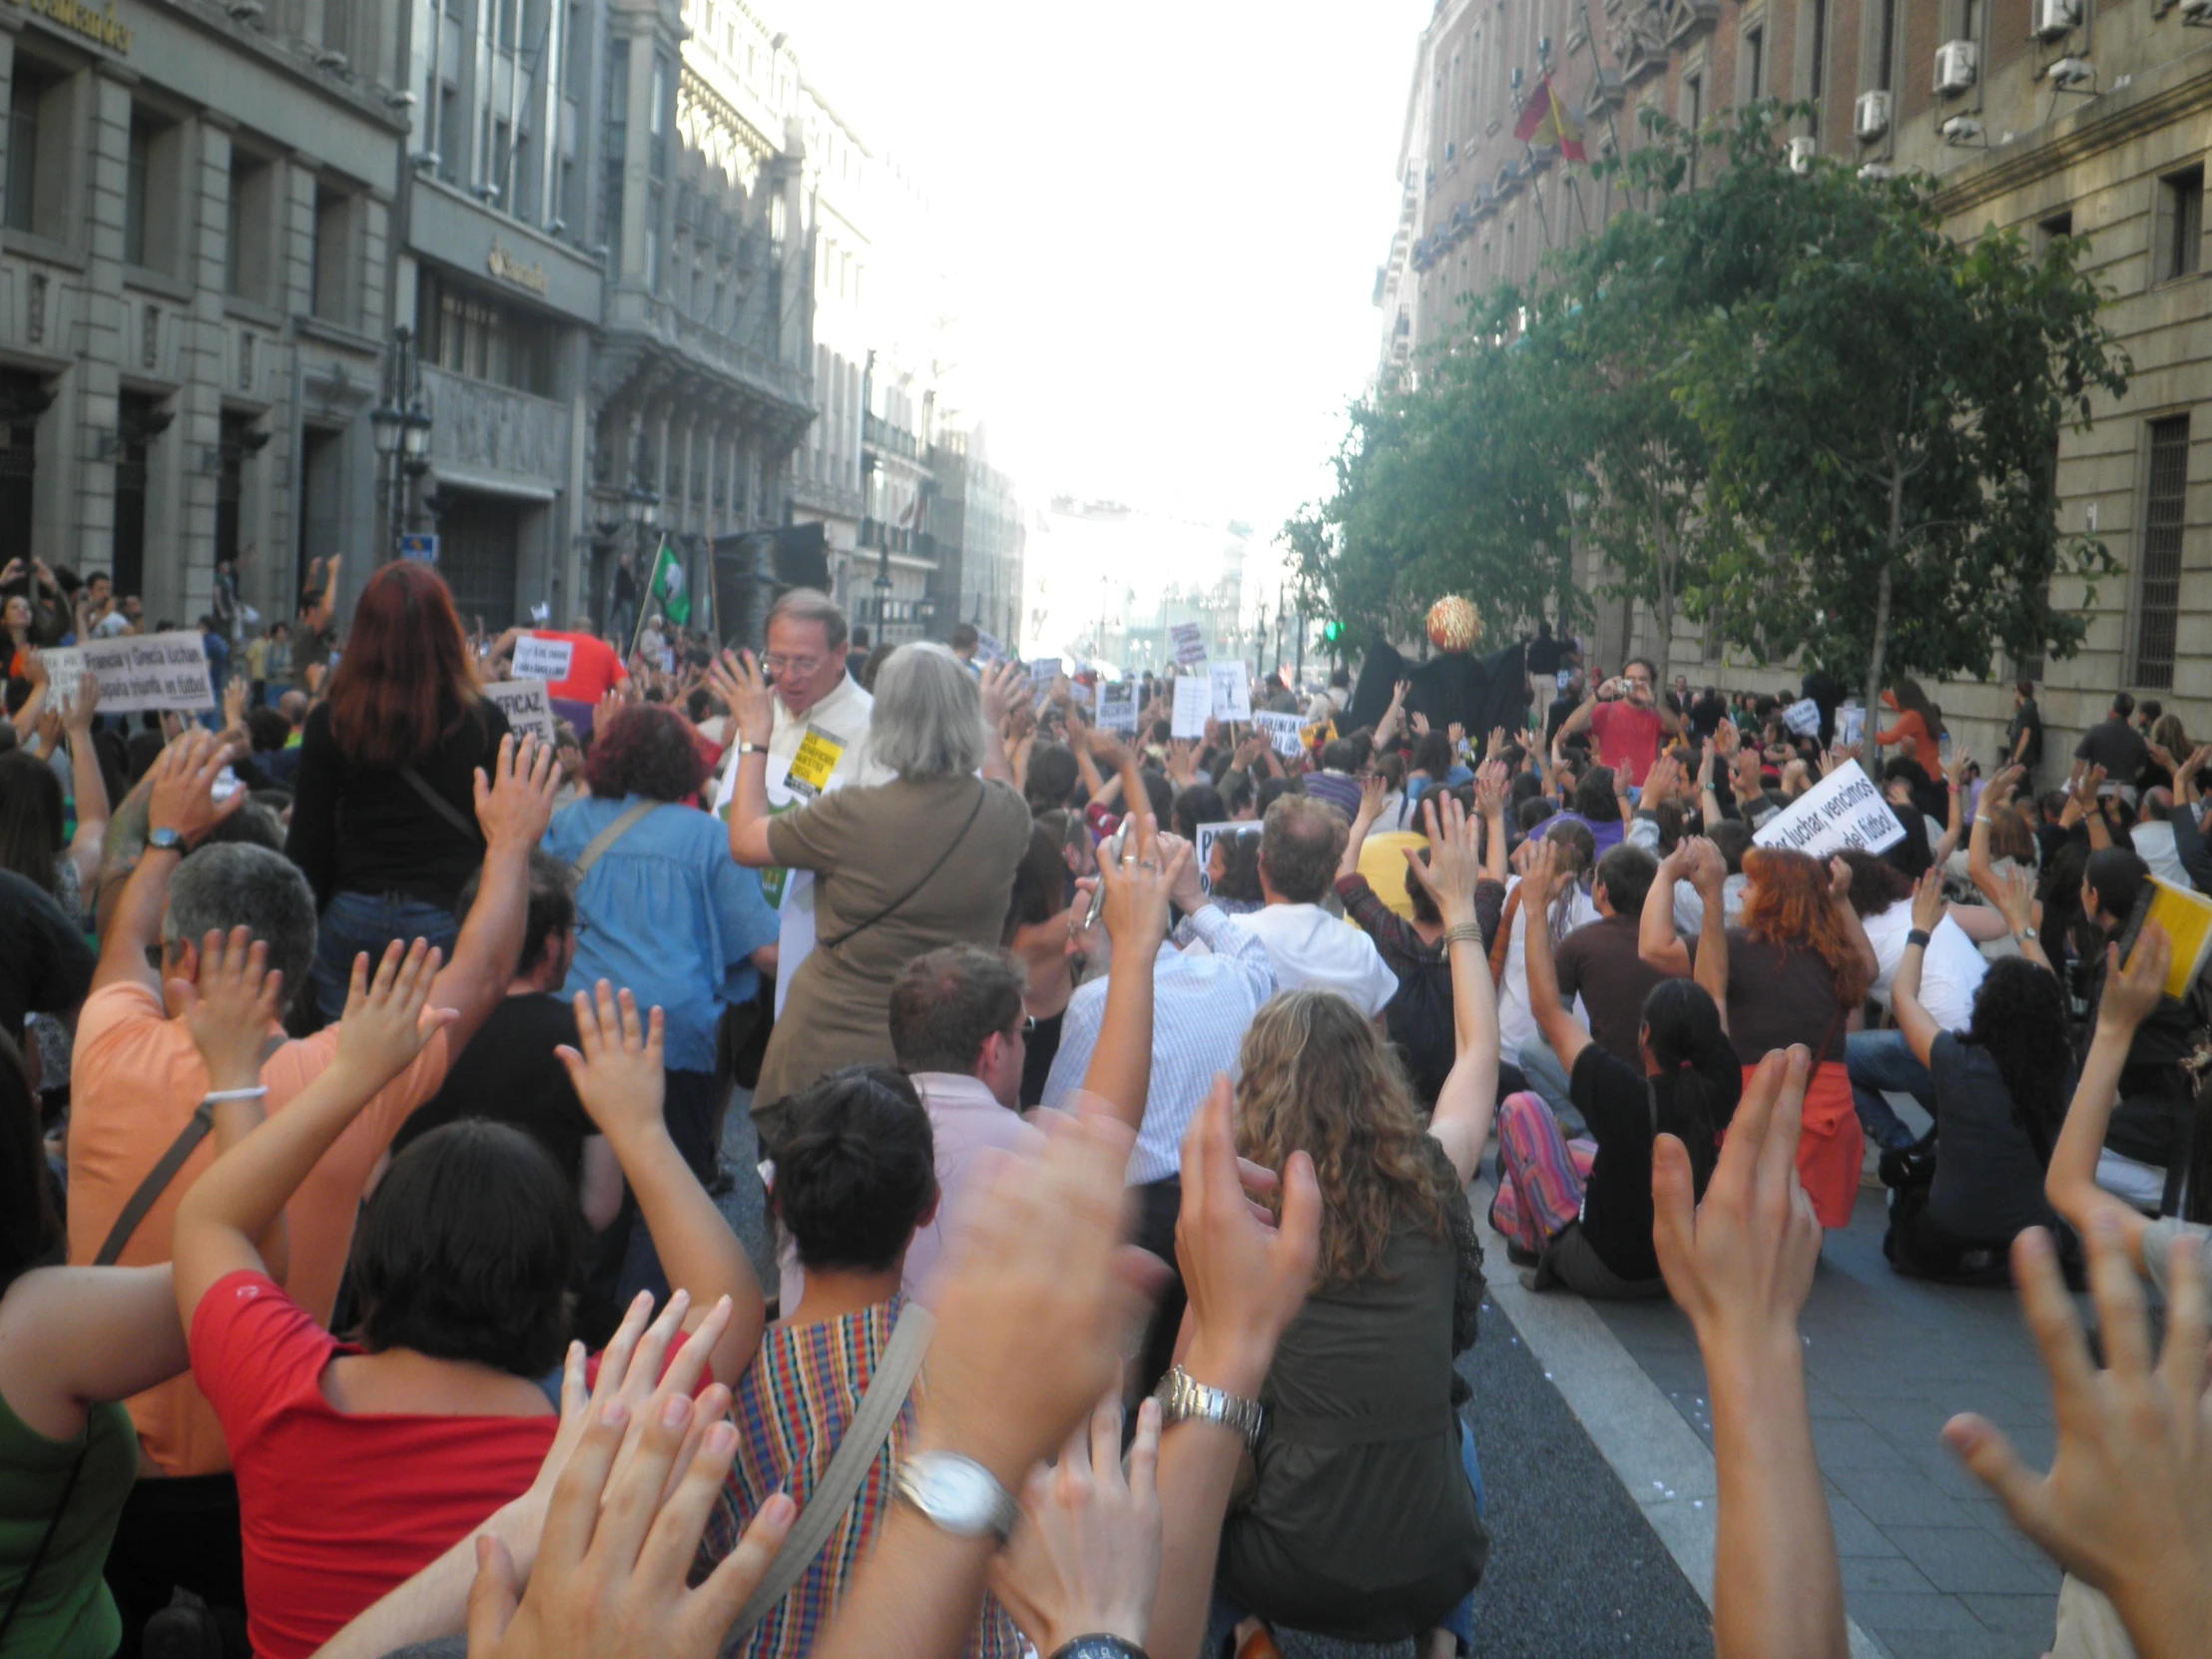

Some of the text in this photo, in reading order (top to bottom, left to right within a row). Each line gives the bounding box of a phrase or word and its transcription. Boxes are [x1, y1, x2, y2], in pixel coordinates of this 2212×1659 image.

[101, 678, 129, 703] spaña
[1782, 810, 1831, 847] luchar,
[1820, 778, 1875, 821] vencimos
[1843, 807, 1898, 849] del fútbol.
